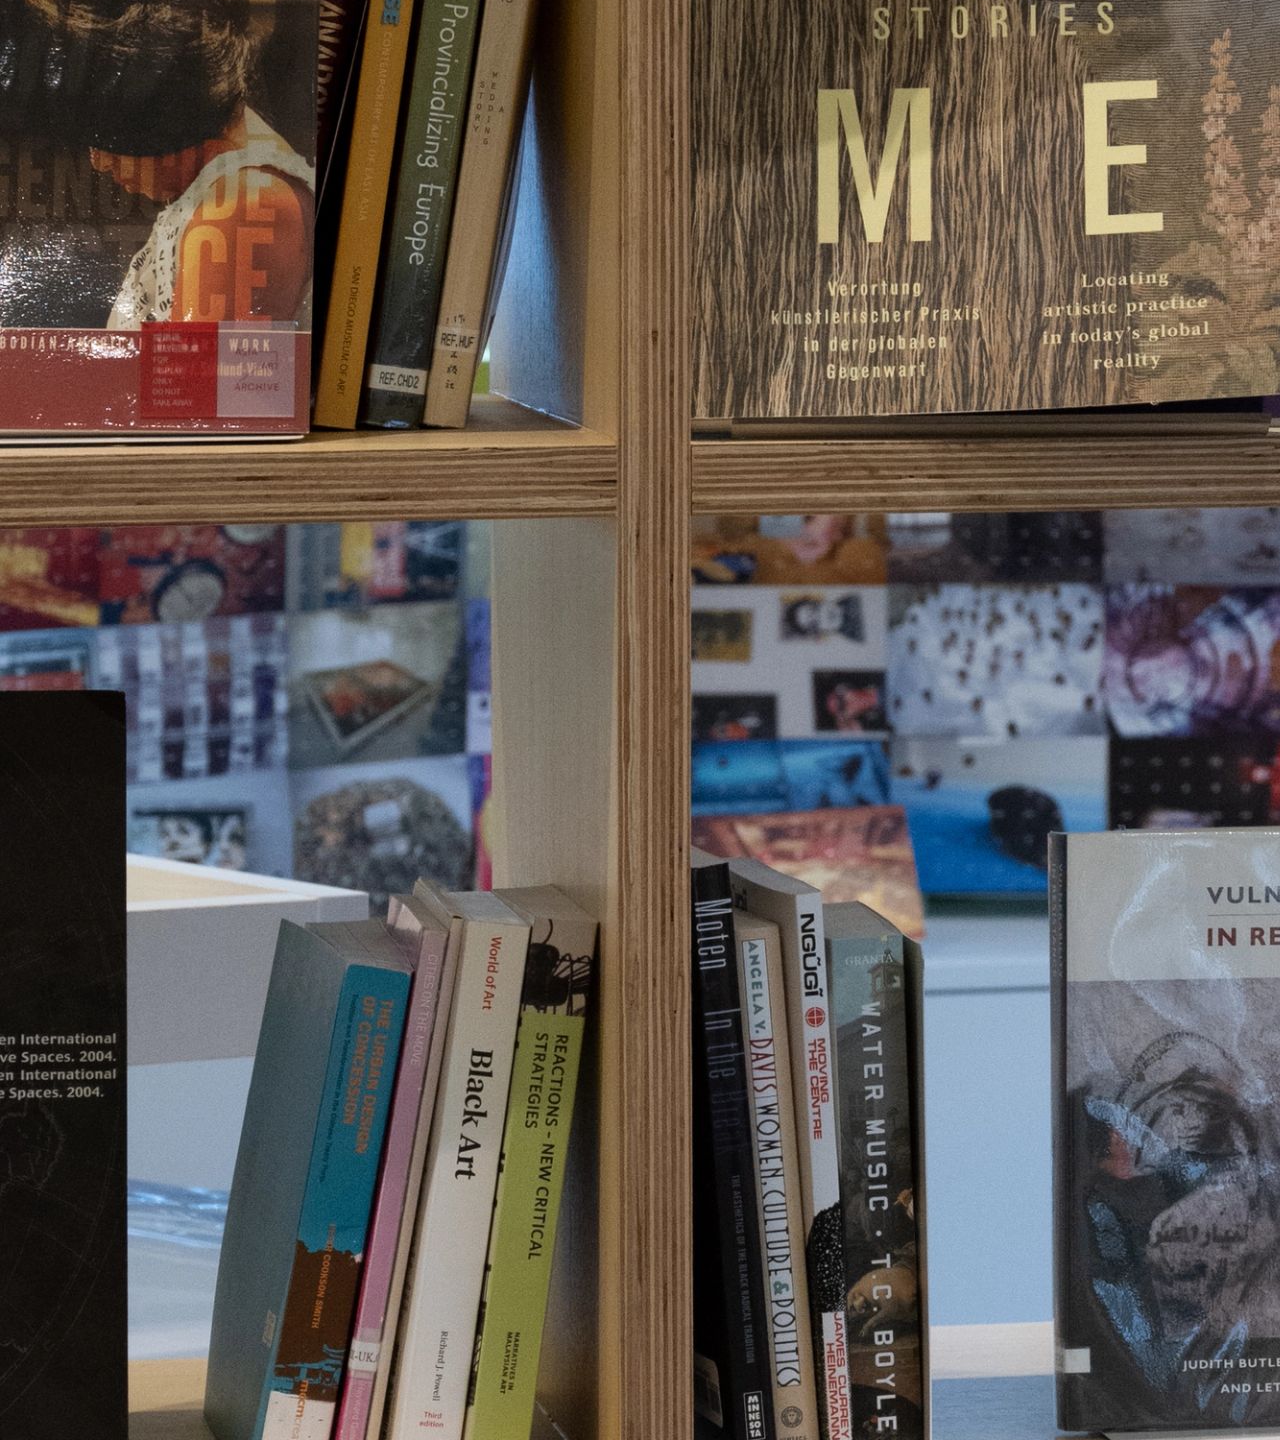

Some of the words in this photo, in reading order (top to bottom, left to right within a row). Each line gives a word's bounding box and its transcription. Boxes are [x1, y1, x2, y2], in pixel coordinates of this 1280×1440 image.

[873, 1, 1113, 43] STORIES
[417, 4, 468, 167] Provincializing
[409, 184, 440, 265] Europe
[1207, 928, 1236, 946] IN
[462, 1049, 492, 1126] Black
[525, 1033, 548, 1128] STRATEGIES
[545, 1035, 568, 1126] REACTIONS
[807, 1038, 822, 1066] THE
[814, 1038, 830, 1104] MOVING
[860, 1002, 884, 1101] WATER
[808, 1068, 823, 1139] CENTRE
[455, 1134, 480, 1179] Art
[539, 1144, 554, 1181] NEW
[866, 1120, 889, 1211] MUSIC
[529, 1187, 548, 1259] CRITICAL
